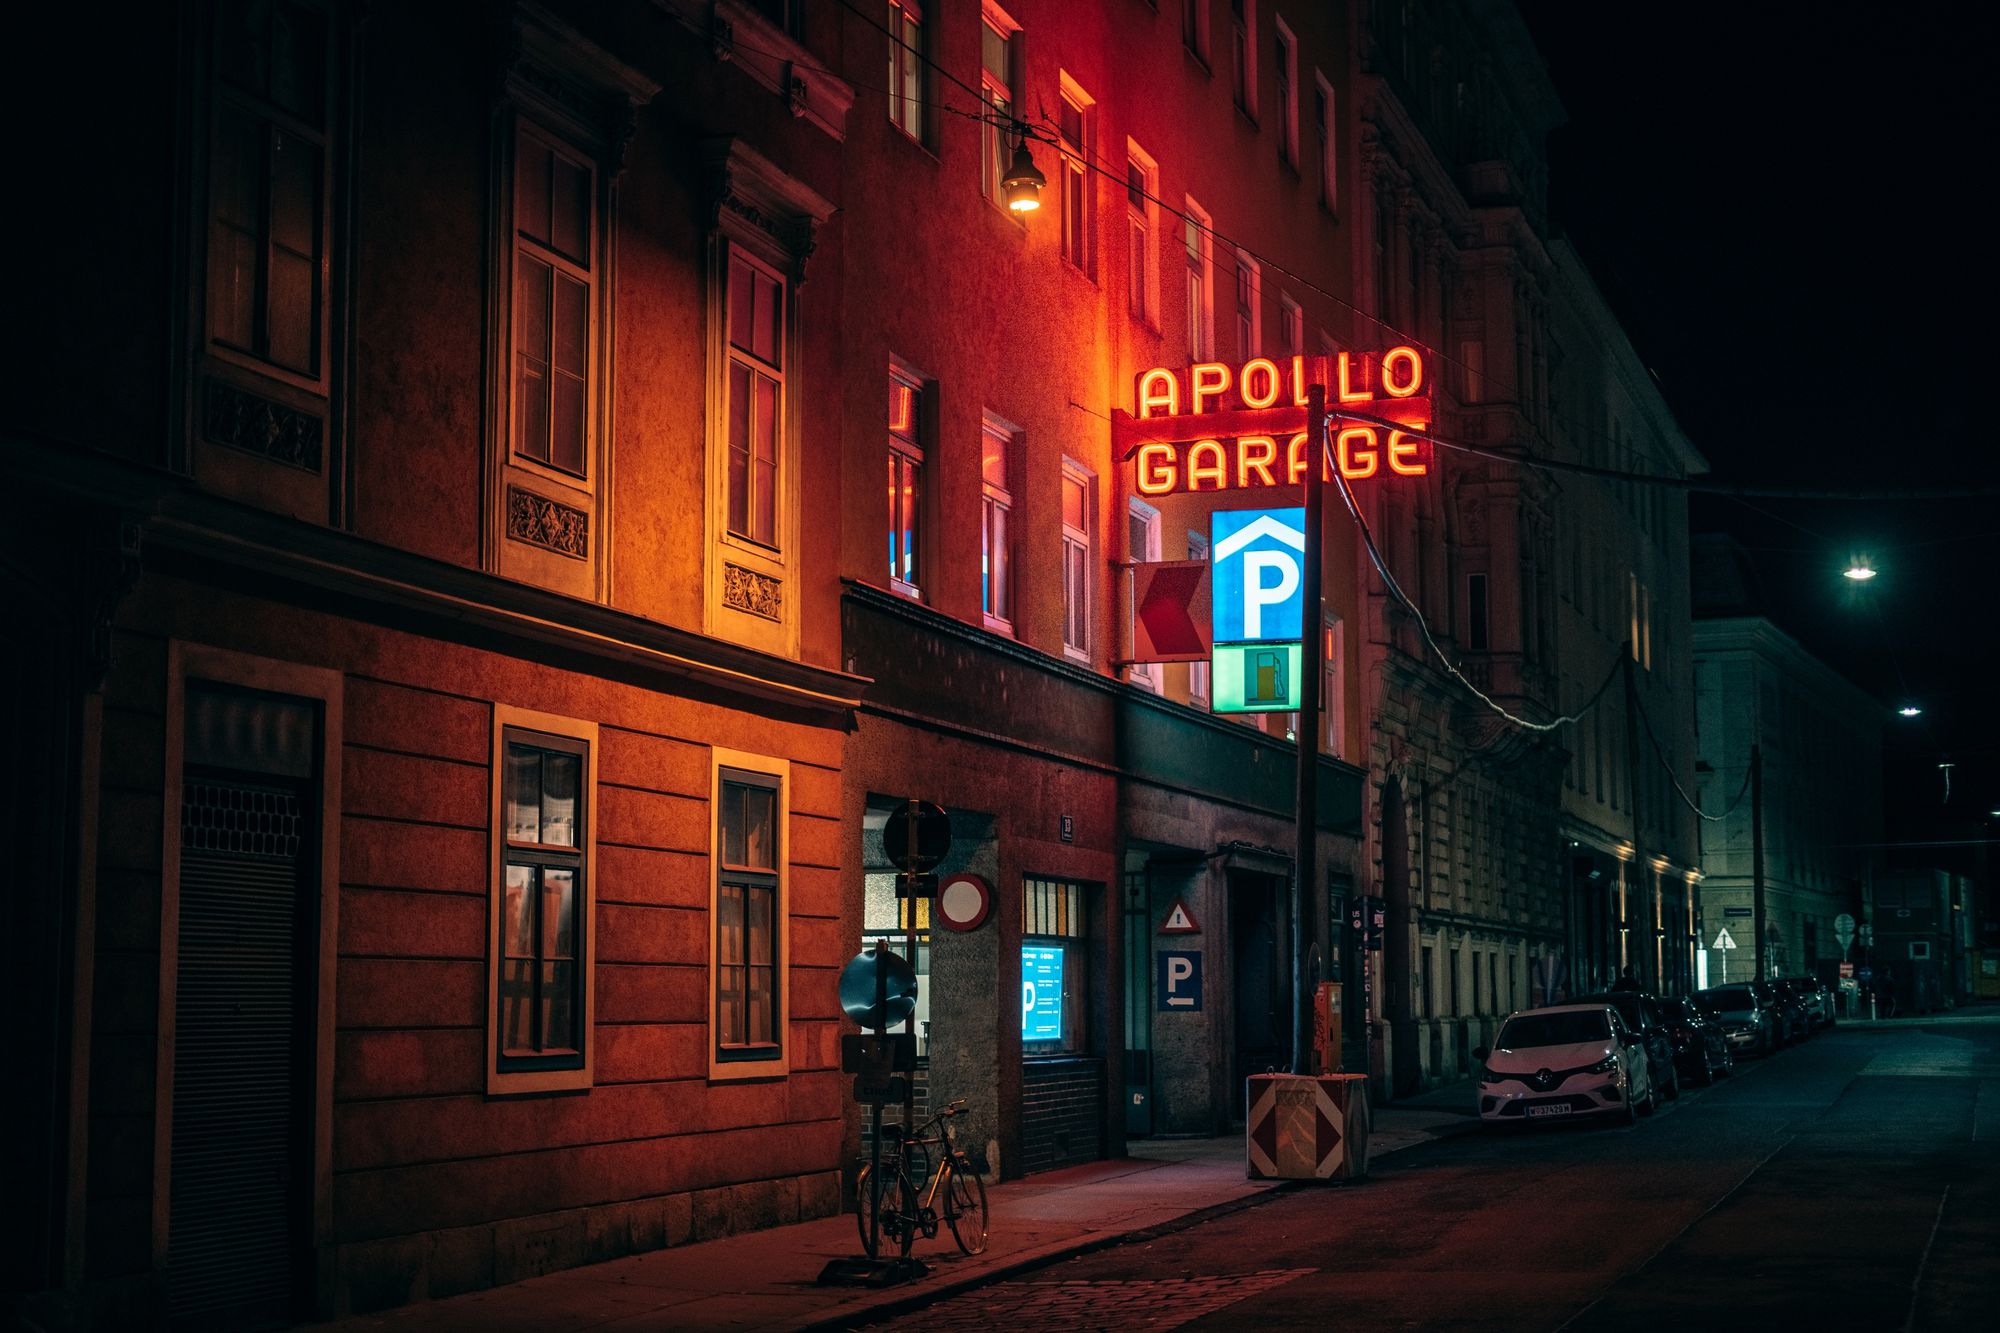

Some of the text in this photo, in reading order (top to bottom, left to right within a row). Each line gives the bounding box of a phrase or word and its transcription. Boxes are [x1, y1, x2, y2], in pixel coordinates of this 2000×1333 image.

[1139, 346, 1422, 419] APOLLO
[1137, 423, 1426, 495] GARAGE
[1243, 550, 1300, 639] P
[1022, 981, 1036, 1030] P
[1168, 957, 1193, 993] P
